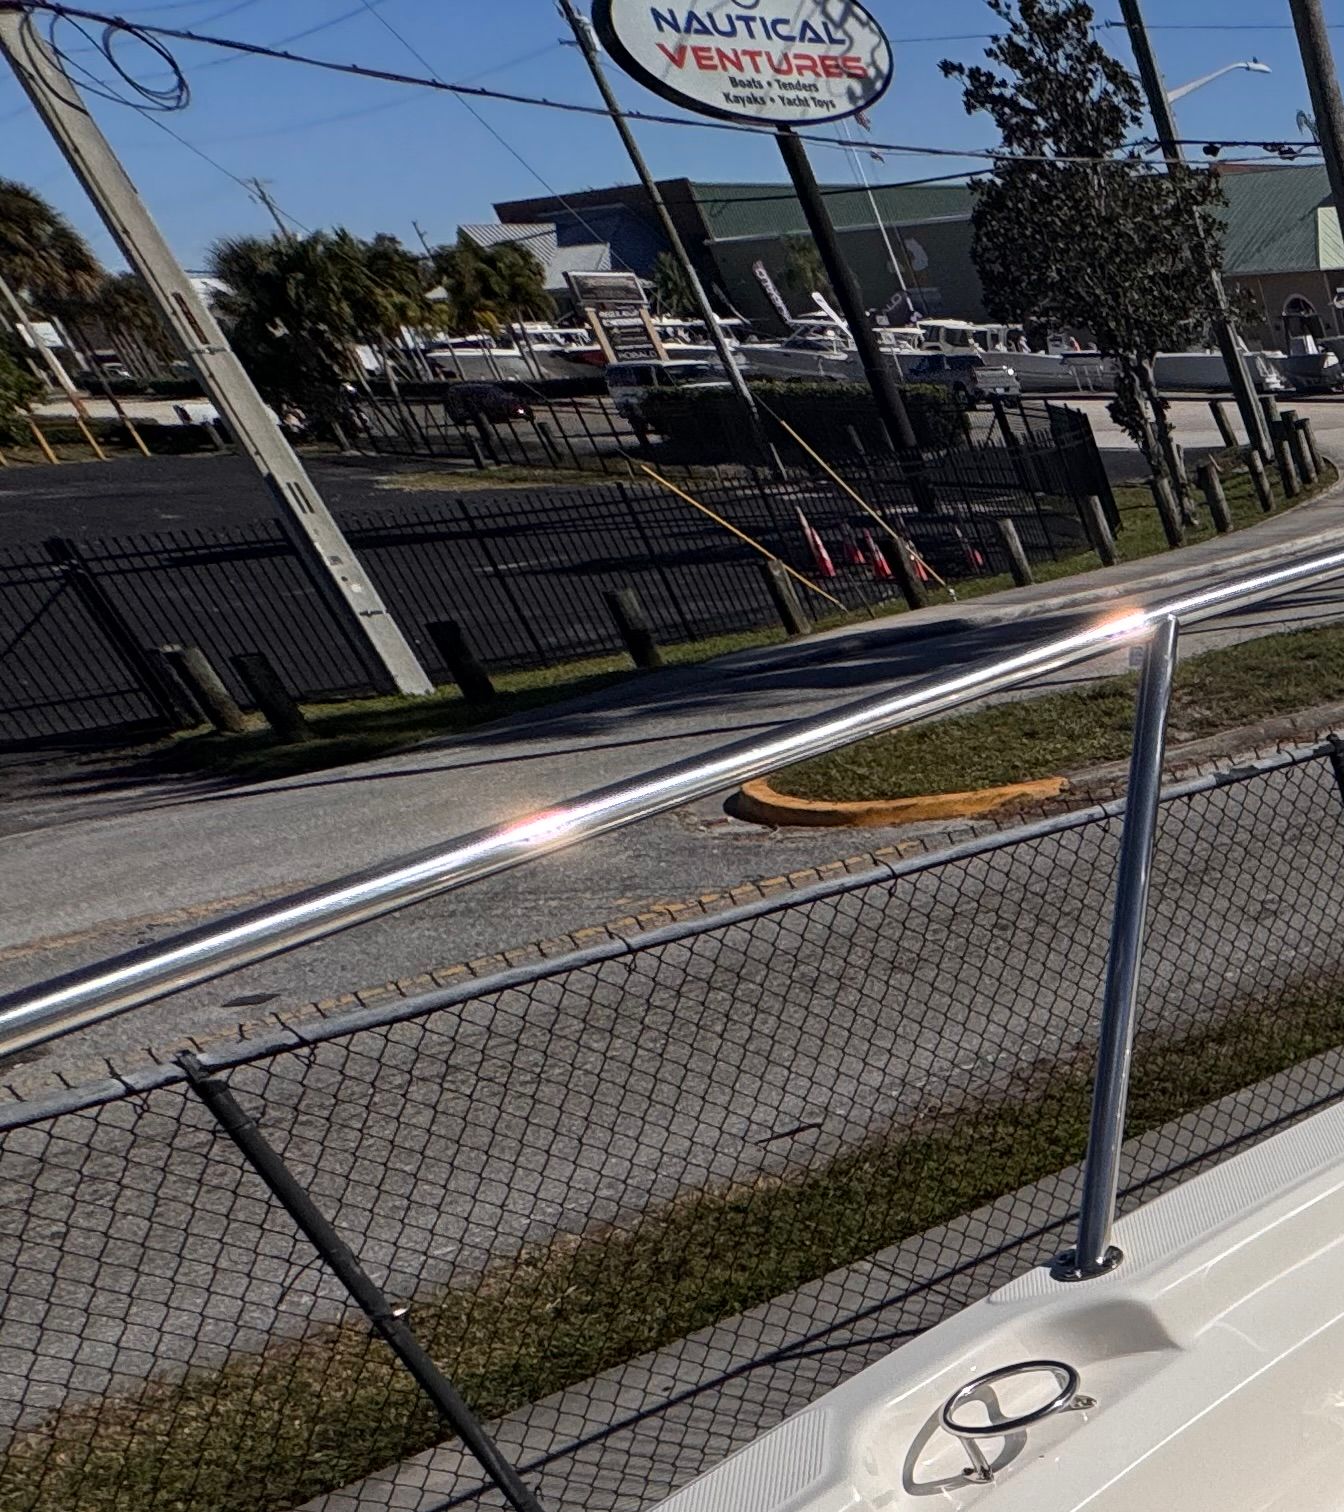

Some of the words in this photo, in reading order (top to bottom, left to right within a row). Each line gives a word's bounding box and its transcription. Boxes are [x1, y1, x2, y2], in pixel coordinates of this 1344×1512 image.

[650, 7, 848, 45] NAUTICAL
[656, 42, 869, 79] VENTURES
[729, 76, 763, 90] Boats
[775, 79, 819, 93] Tenders
[723, 92, 766, 108] Kayaks
[779, 94, 810, 108] Yacht
[812, 97, 836, 112] Toys
